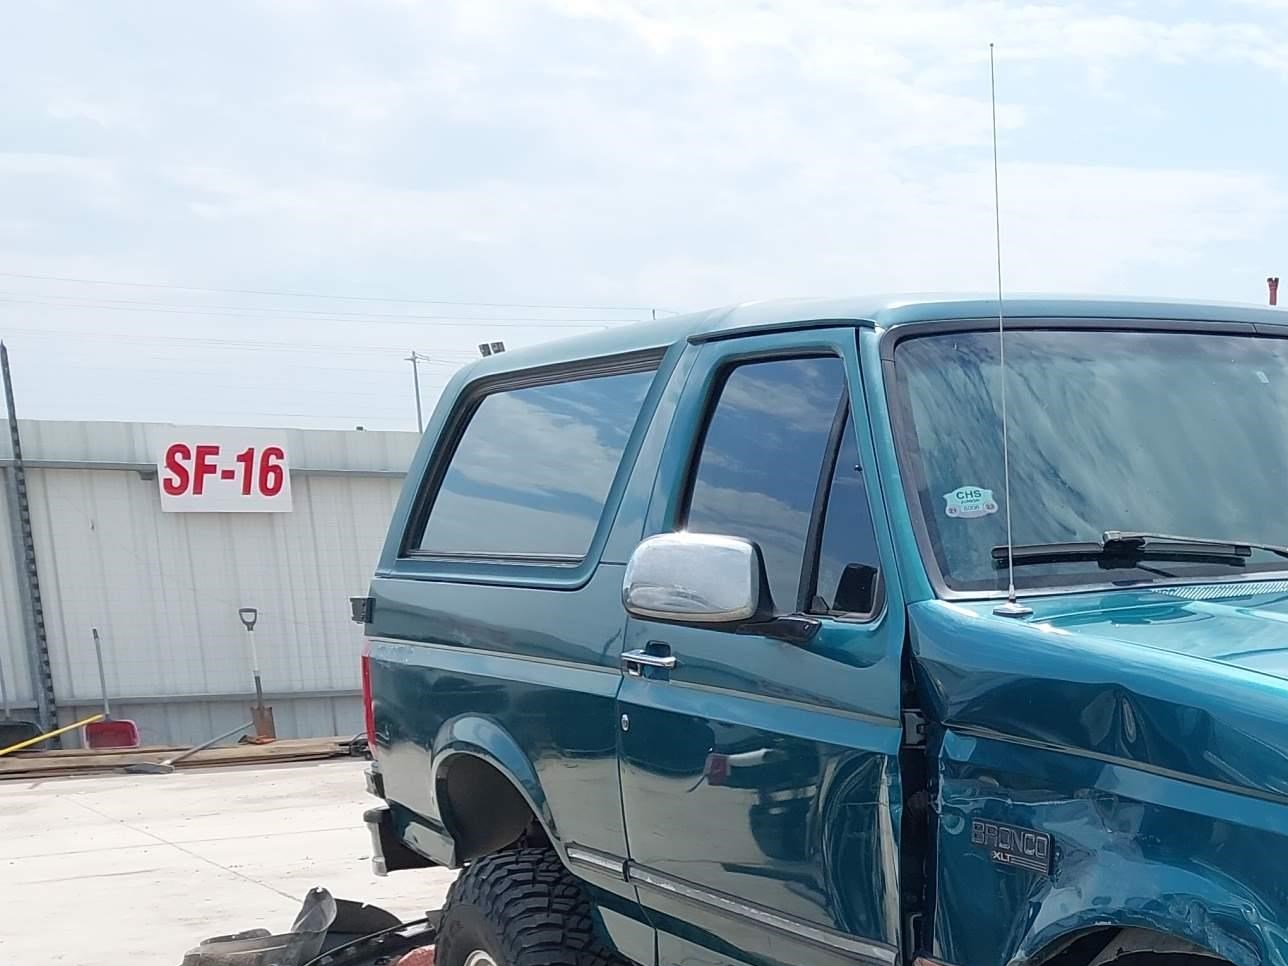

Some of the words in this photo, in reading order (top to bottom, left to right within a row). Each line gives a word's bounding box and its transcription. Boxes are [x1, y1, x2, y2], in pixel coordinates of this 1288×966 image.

[162, 443, 285, 496] SF-16
[956, 490, 982, 500] CHS
[971, 820, 1048, 858] BRONCO
[992, 850, 1012, 863] XLT
